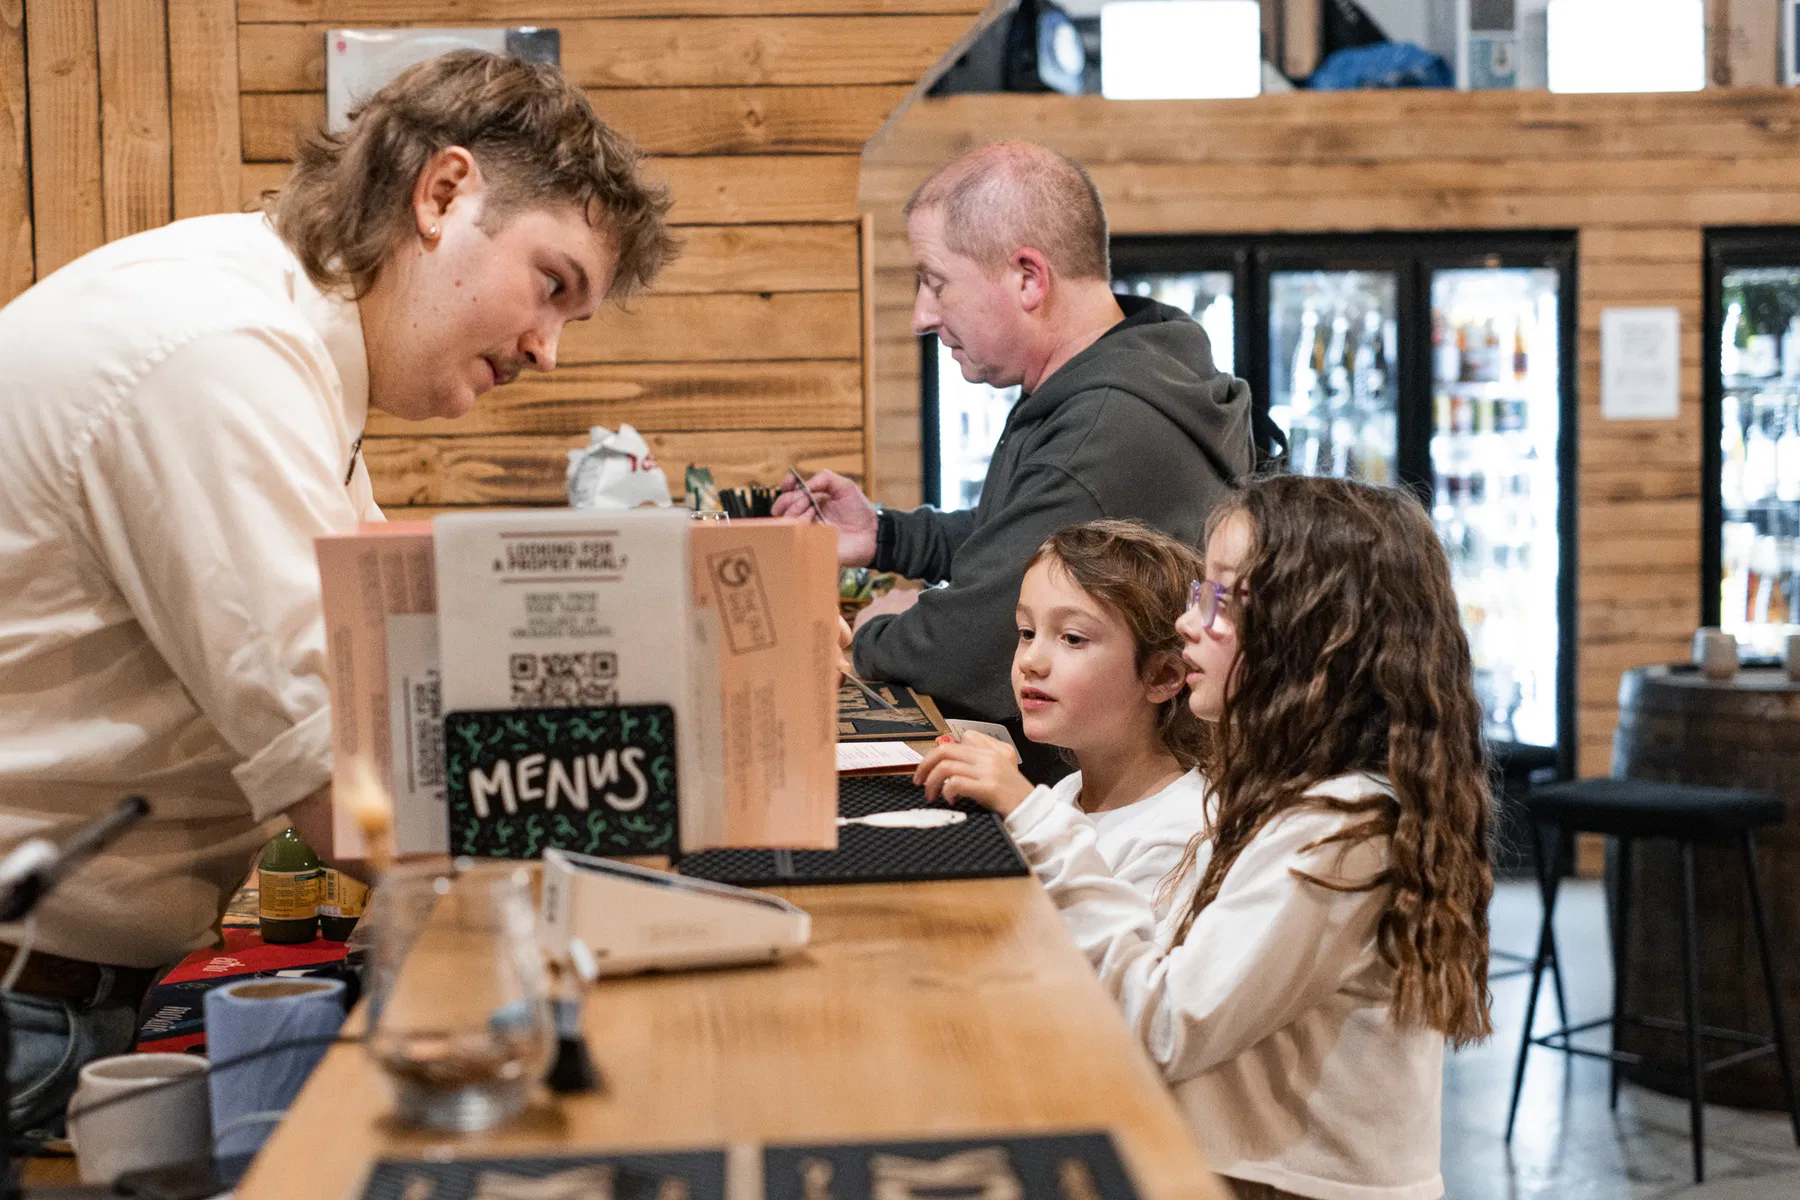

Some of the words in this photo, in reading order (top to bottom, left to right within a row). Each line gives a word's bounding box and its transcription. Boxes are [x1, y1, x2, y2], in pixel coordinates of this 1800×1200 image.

[506, 543, 576, 555] LOOKING
[580, 541, 613, 555] FOR
[508, 557, 571, 570] PROPER
